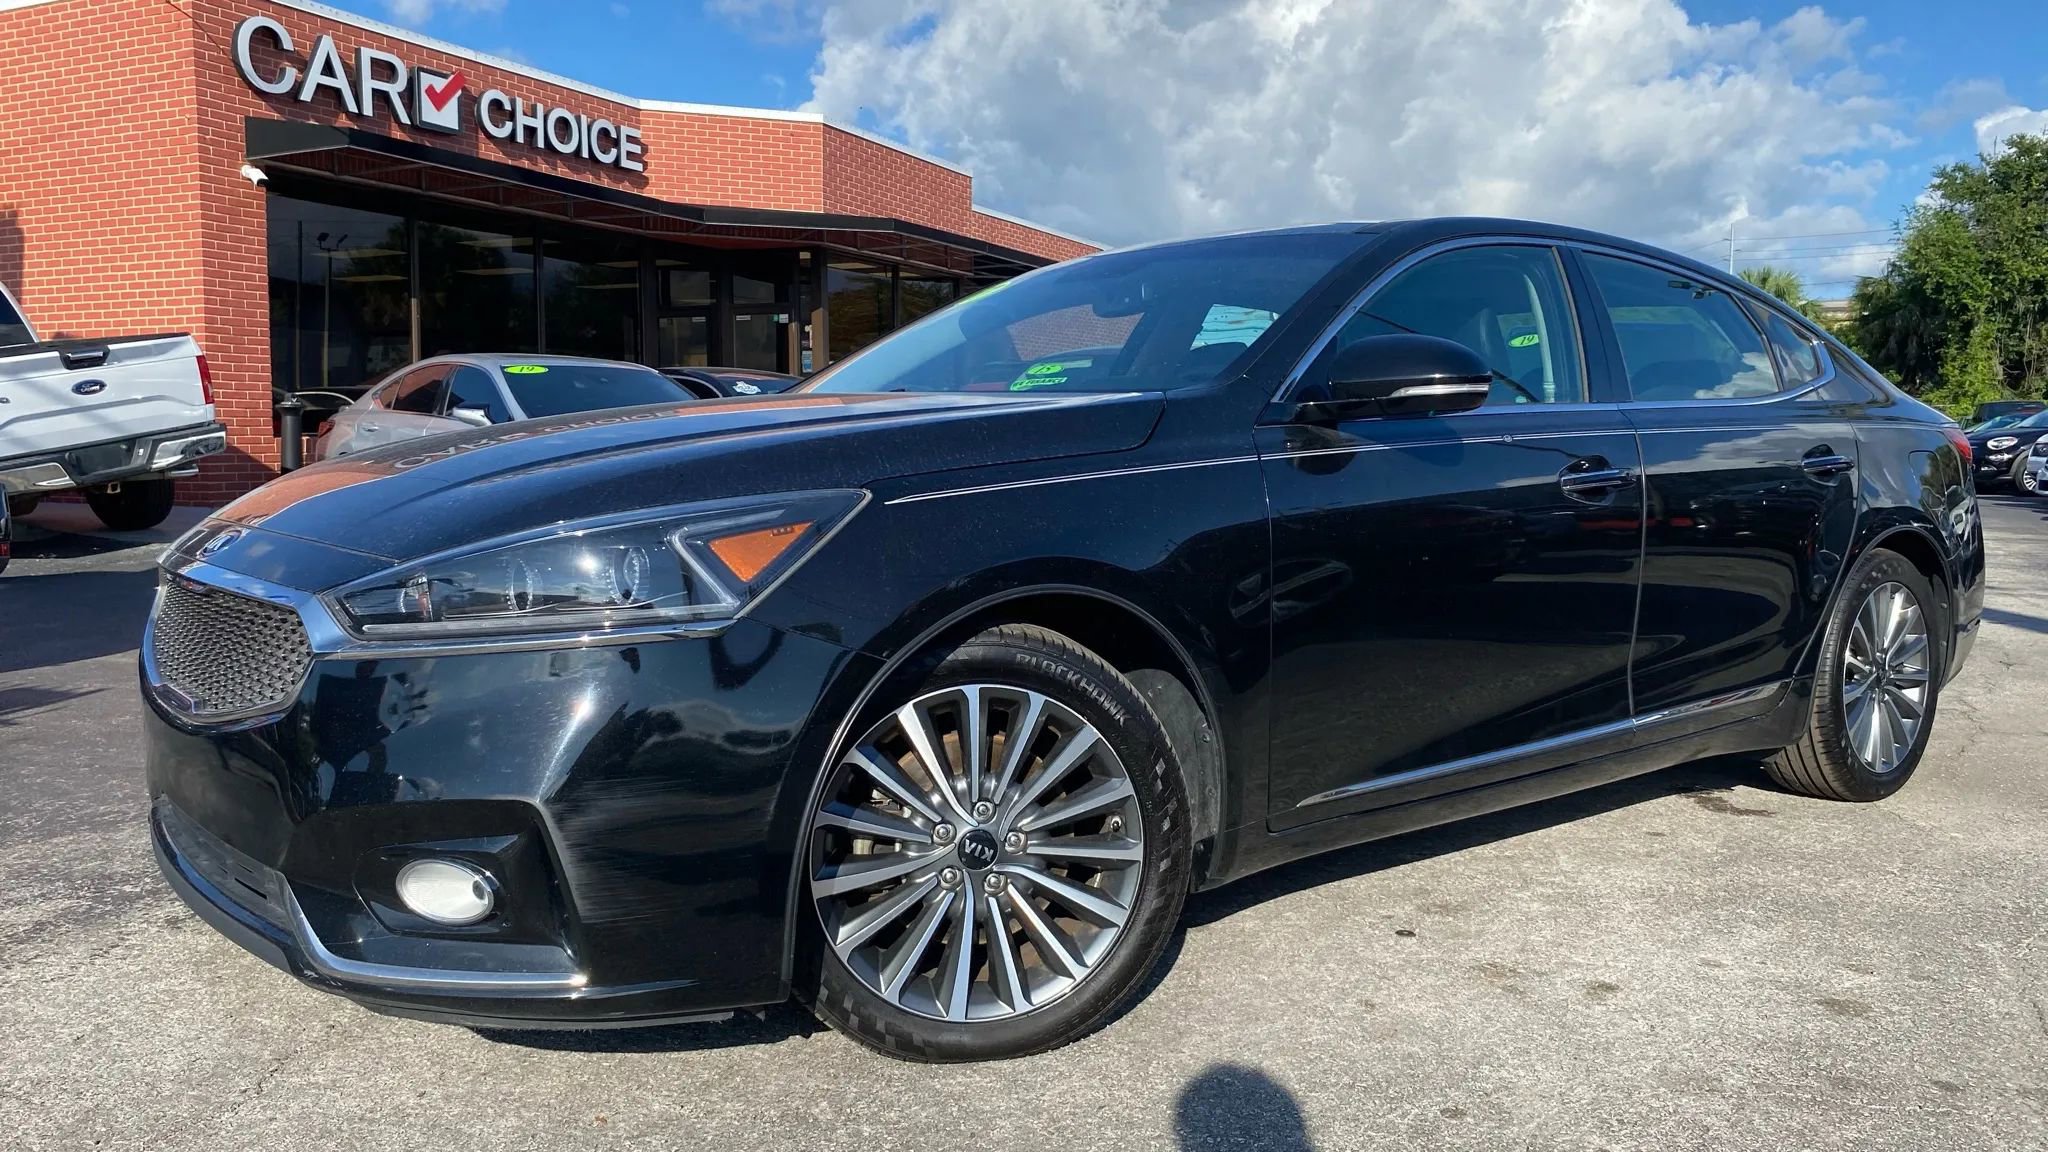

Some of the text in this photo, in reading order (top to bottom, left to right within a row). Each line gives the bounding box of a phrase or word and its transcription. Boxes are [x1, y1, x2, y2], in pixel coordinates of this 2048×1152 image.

[232, 16, 645, 172] CAR CHOICE
[965, 838, 995, 862] KIA
